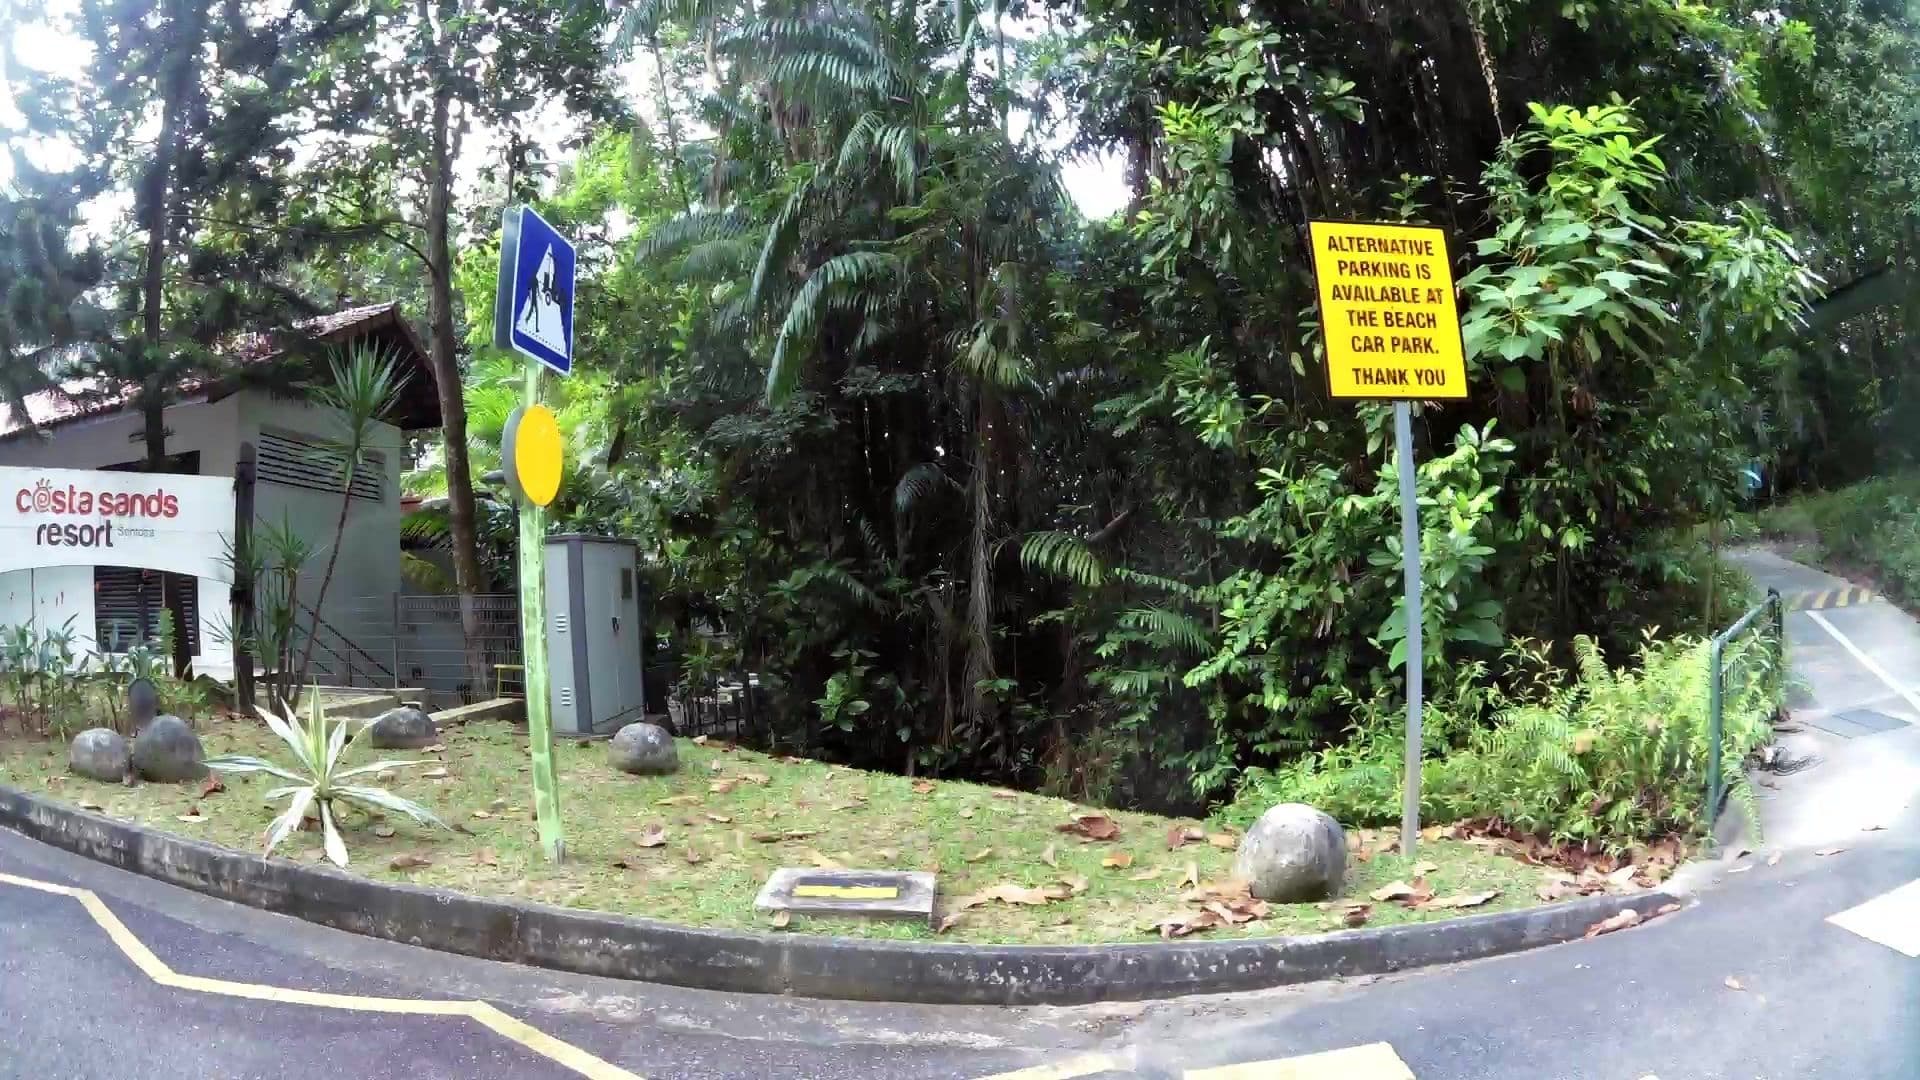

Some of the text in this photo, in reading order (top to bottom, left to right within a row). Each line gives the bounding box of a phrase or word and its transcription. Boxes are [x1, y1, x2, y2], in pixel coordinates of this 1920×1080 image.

[1328, 236, 1434, 256] ALTERNATIVE
[1338, 260, 1431, 280] PARKING IS
[1332, 284, 1443, 305] AVAILABLE AT
[1346, 310, 1437, 329] THE BEACH
[1351, 335, 1439, 354] CAR PARK.
[1352, 368, 1446, 386] THANK YOU
[16, 480, 179, 518] costa sands
[36, 519, 114, 548] resort
